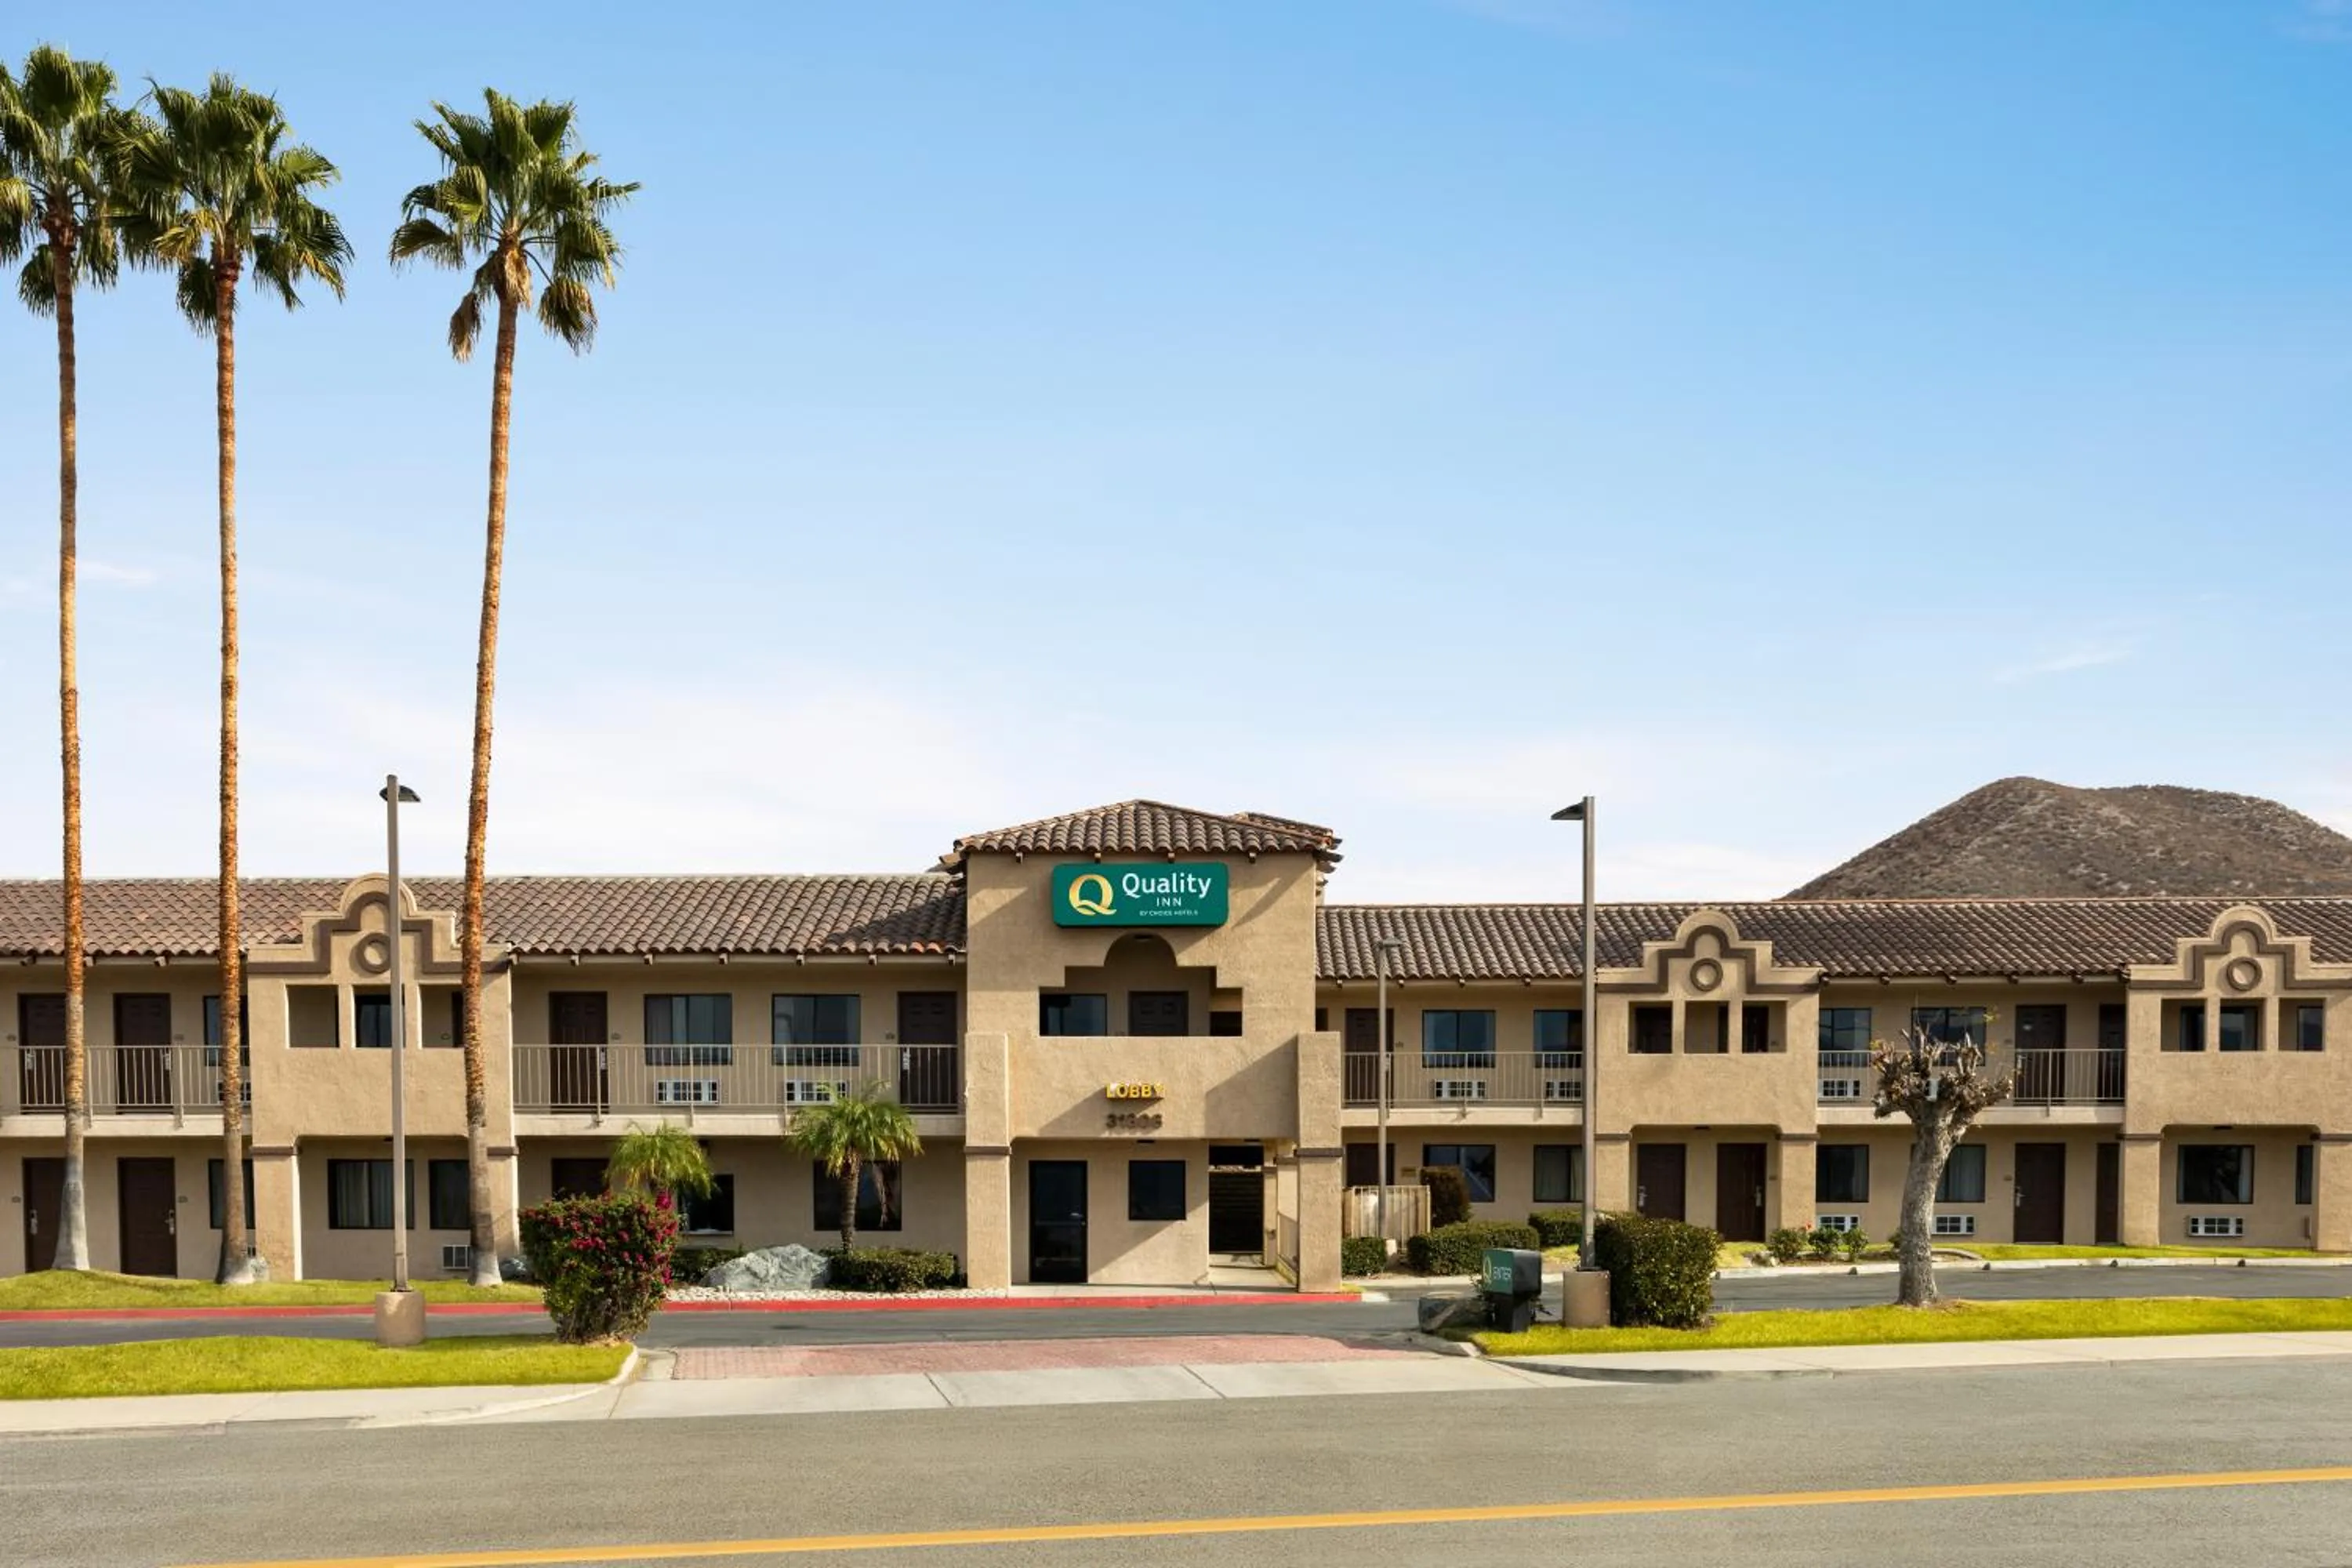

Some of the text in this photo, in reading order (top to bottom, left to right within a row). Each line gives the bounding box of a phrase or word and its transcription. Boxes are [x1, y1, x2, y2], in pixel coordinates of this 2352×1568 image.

[1069, 873, 1117, 916] Q
[1122, 873, 1211, 898] Quality
[1156, 897, 1181, 907] INN
[1105, 1083, 1164, 1099] LOBBY
